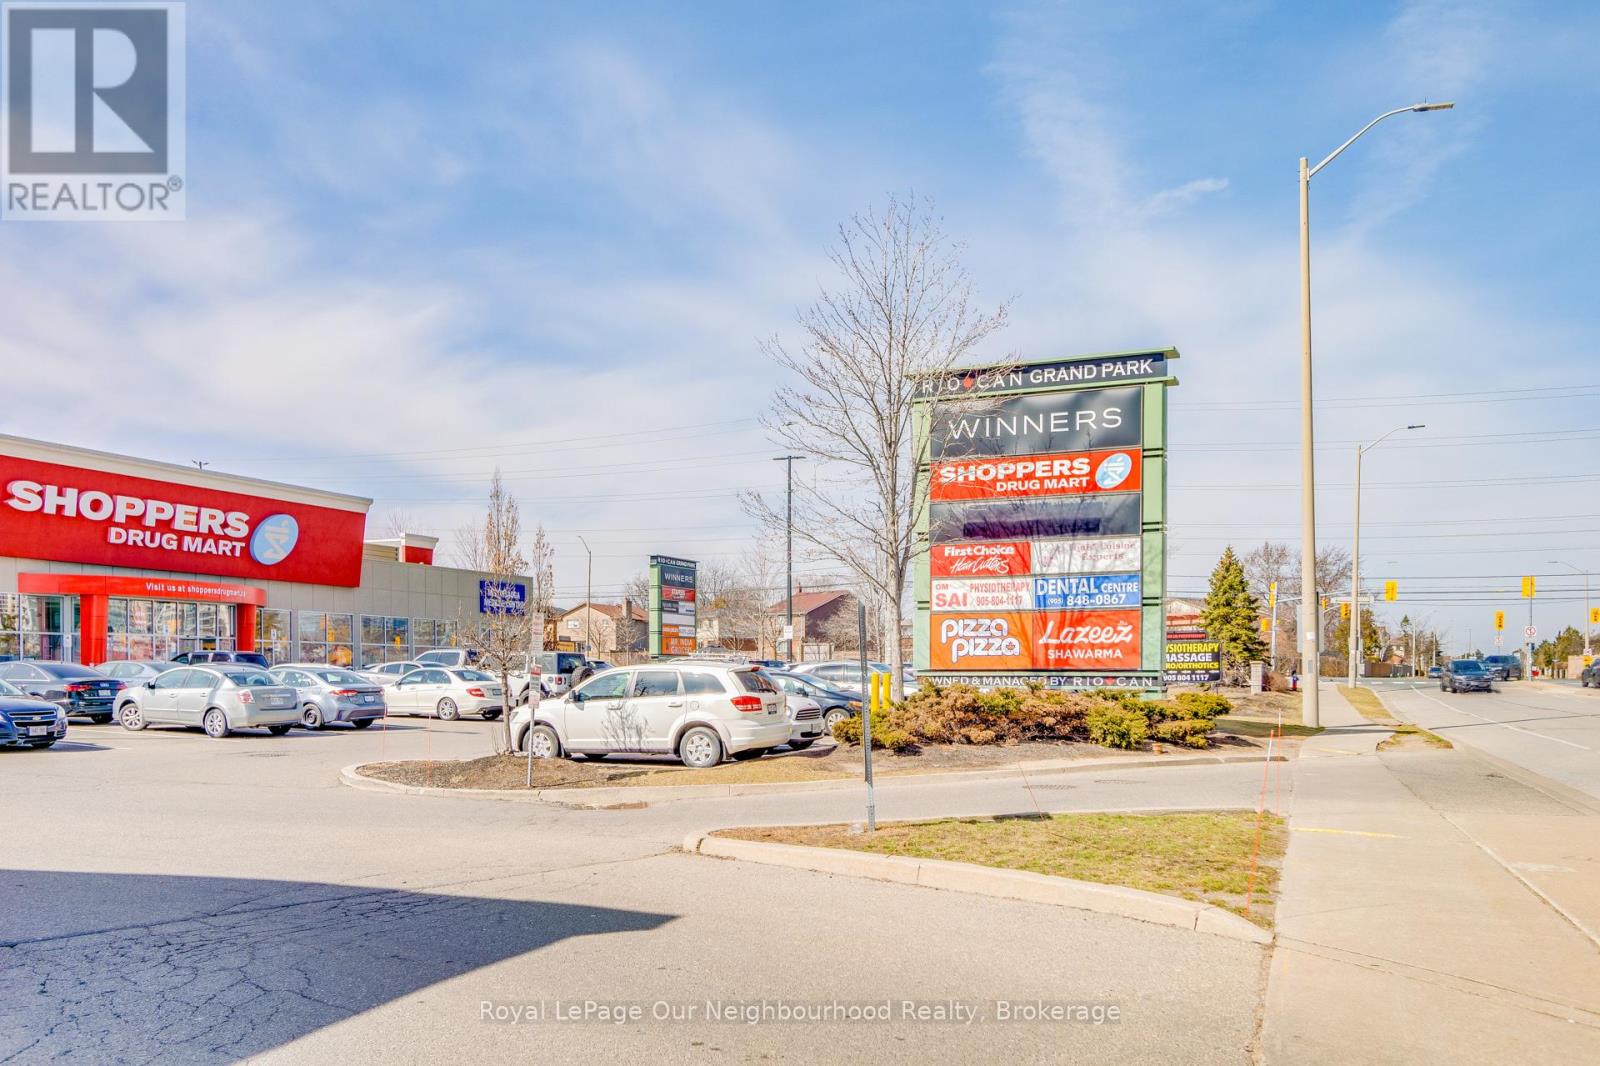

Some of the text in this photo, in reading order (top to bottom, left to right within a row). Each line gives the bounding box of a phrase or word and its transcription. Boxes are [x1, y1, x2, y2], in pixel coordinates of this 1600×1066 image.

[1030, 364, 1097, 384] GRAND
[1102, 358, 1153, 378] PARK
[949, 407, 1122, 440] WINNERS
[939, 457, 1091, 483] SHOPPERS
[996, 476, 1090, 492] DRUG MART
[5, 480, 250, 538] SHOPPERS
[107, 526, 245, 558] DRUG MART
[944, 544, 1015, 557] First Choice
[664, 572, 694, 583] WINNERS
[1036, 577, 1139, 595] DENTAL CENTRE
[145, 582, 165, 592] Visit
[969, 582, 1030, 592] PHYSIOTHERAPY
[935, 592, 968, 607] SAI
[1066, 594, 1126, 605] 848-0867
[941, 618, 1008, 644] pizza
[1039, 620, 1133, 644] Lazeez
[952, 637, 1020, 663] pizza
[1048, 649, 1122, 659] SHAWARMA
[971, 677, 980, 685] &
[1050, 677, 1066, 685] BY
[1073, 677, 1105, 686] RIO
[1116, 677, 1152, 686] CAN
